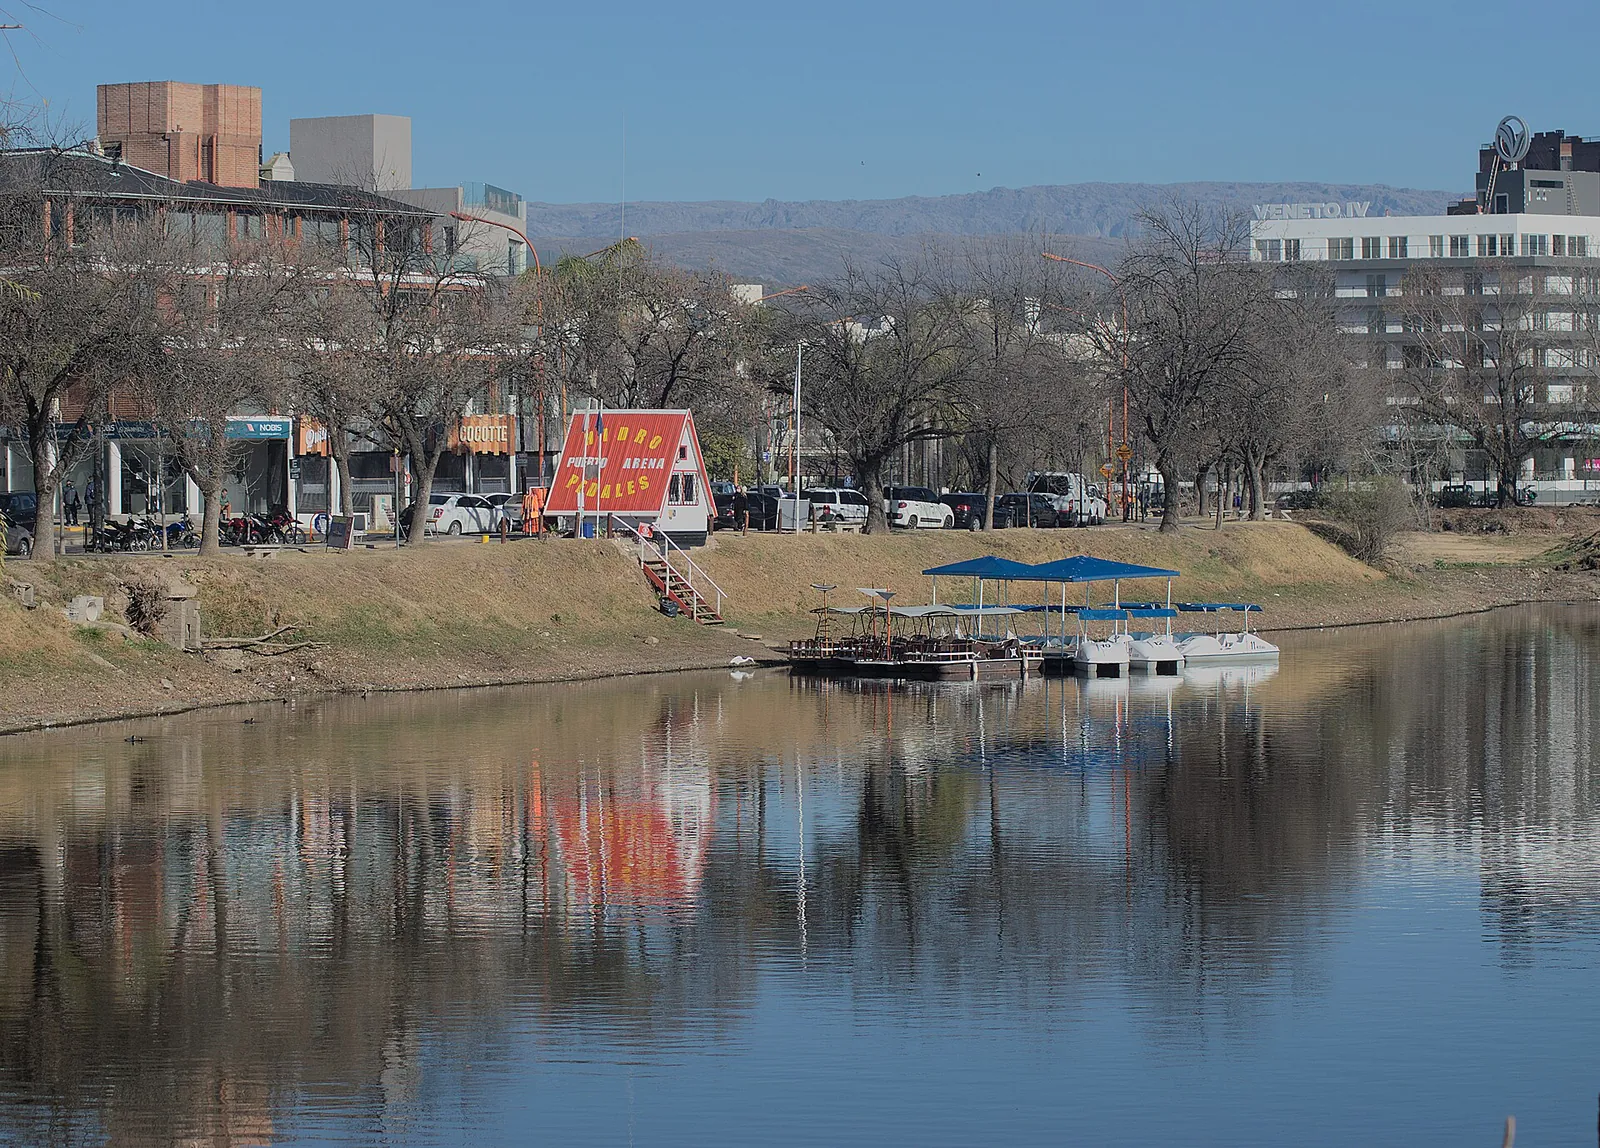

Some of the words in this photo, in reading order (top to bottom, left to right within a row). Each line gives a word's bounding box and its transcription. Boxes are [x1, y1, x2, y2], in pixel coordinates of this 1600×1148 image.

[1252, 203, 1341, 220] VENETO
[1346, 201, 1370, 218] IV
[259, 423, 283, 432] NOBIS
[459, 425, 508, 442] COCOTTE
[622, 457, 665, 470] ARENA
[566, 473, 650, 499] PEDALES
